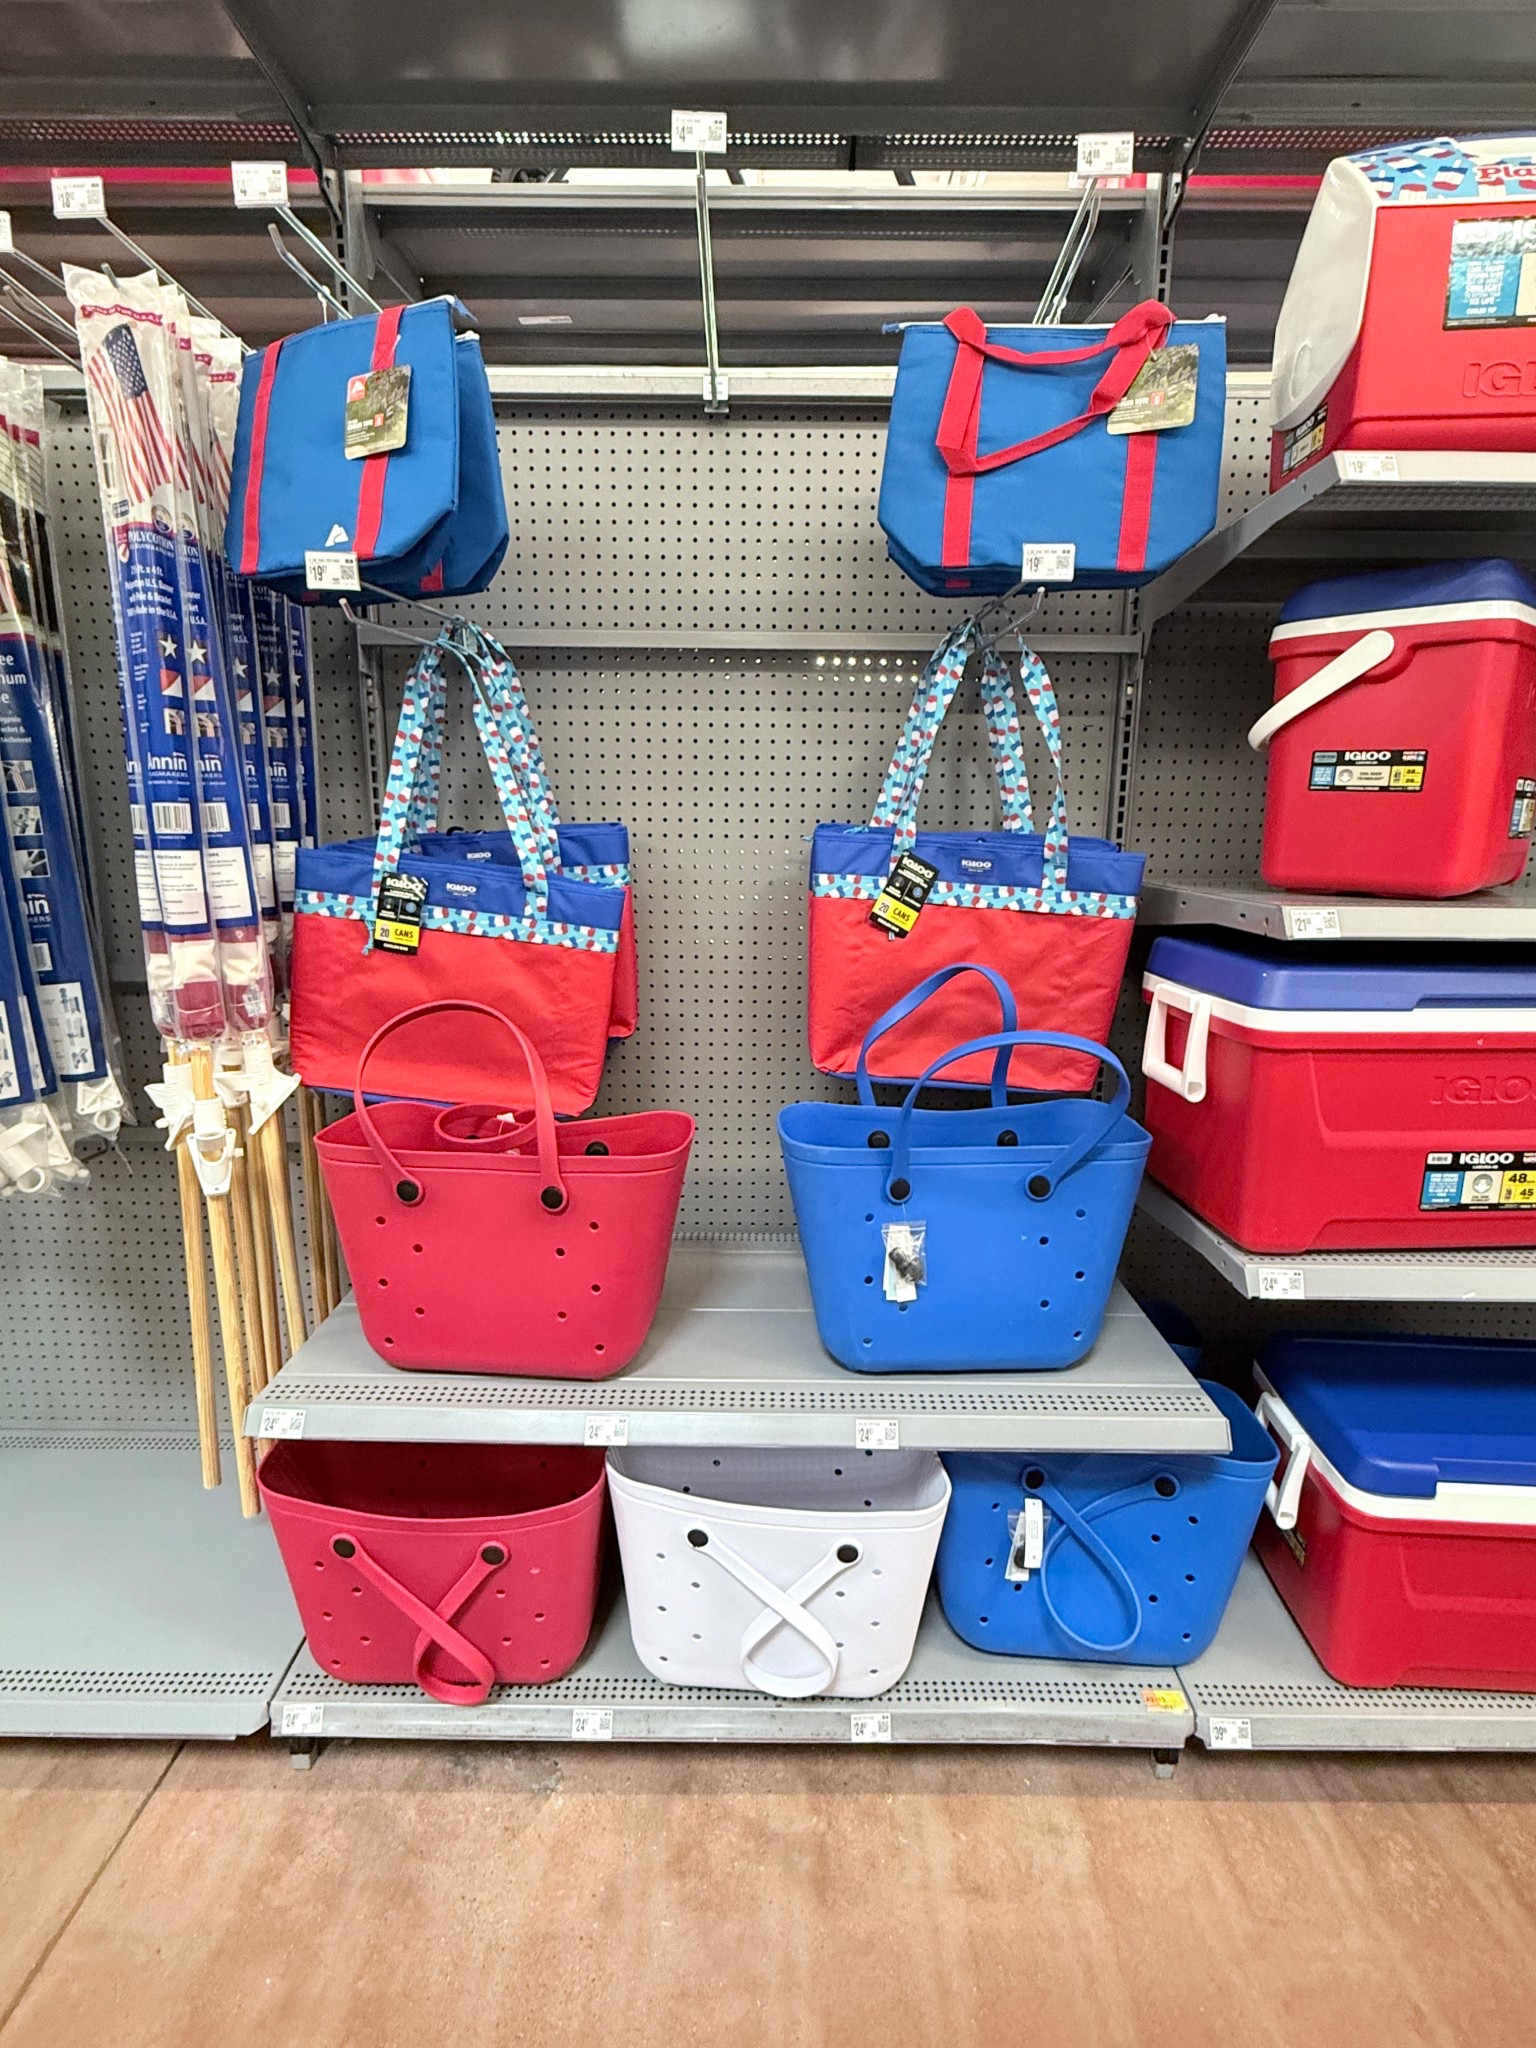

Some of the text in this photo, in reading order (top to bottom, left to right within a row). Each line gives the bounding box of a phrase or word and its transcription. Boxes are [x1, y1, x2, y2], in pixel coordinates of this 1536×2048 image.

[1477, 166, 1536, 179] Pla
[1344, 751, 1392, 760] IGLOO
[466, 852, 492, 860] IGLOO
[902, 856, 935, 880] IGLOO
[962, 859, 992, 868] IGLOO
[446, 882, 476, 892] IGLOO
[878, 902, 911, 922] 20 CANS
[380, 928, 414, 939] 20 CANS
[1430, 1075, 1536, 1105] IGLO
[1459, 1152, 1514, 1164] IGLOO
[1508, 1173, 1528, 1184] 48
[1520, 1188, 1534, 1196] 45
